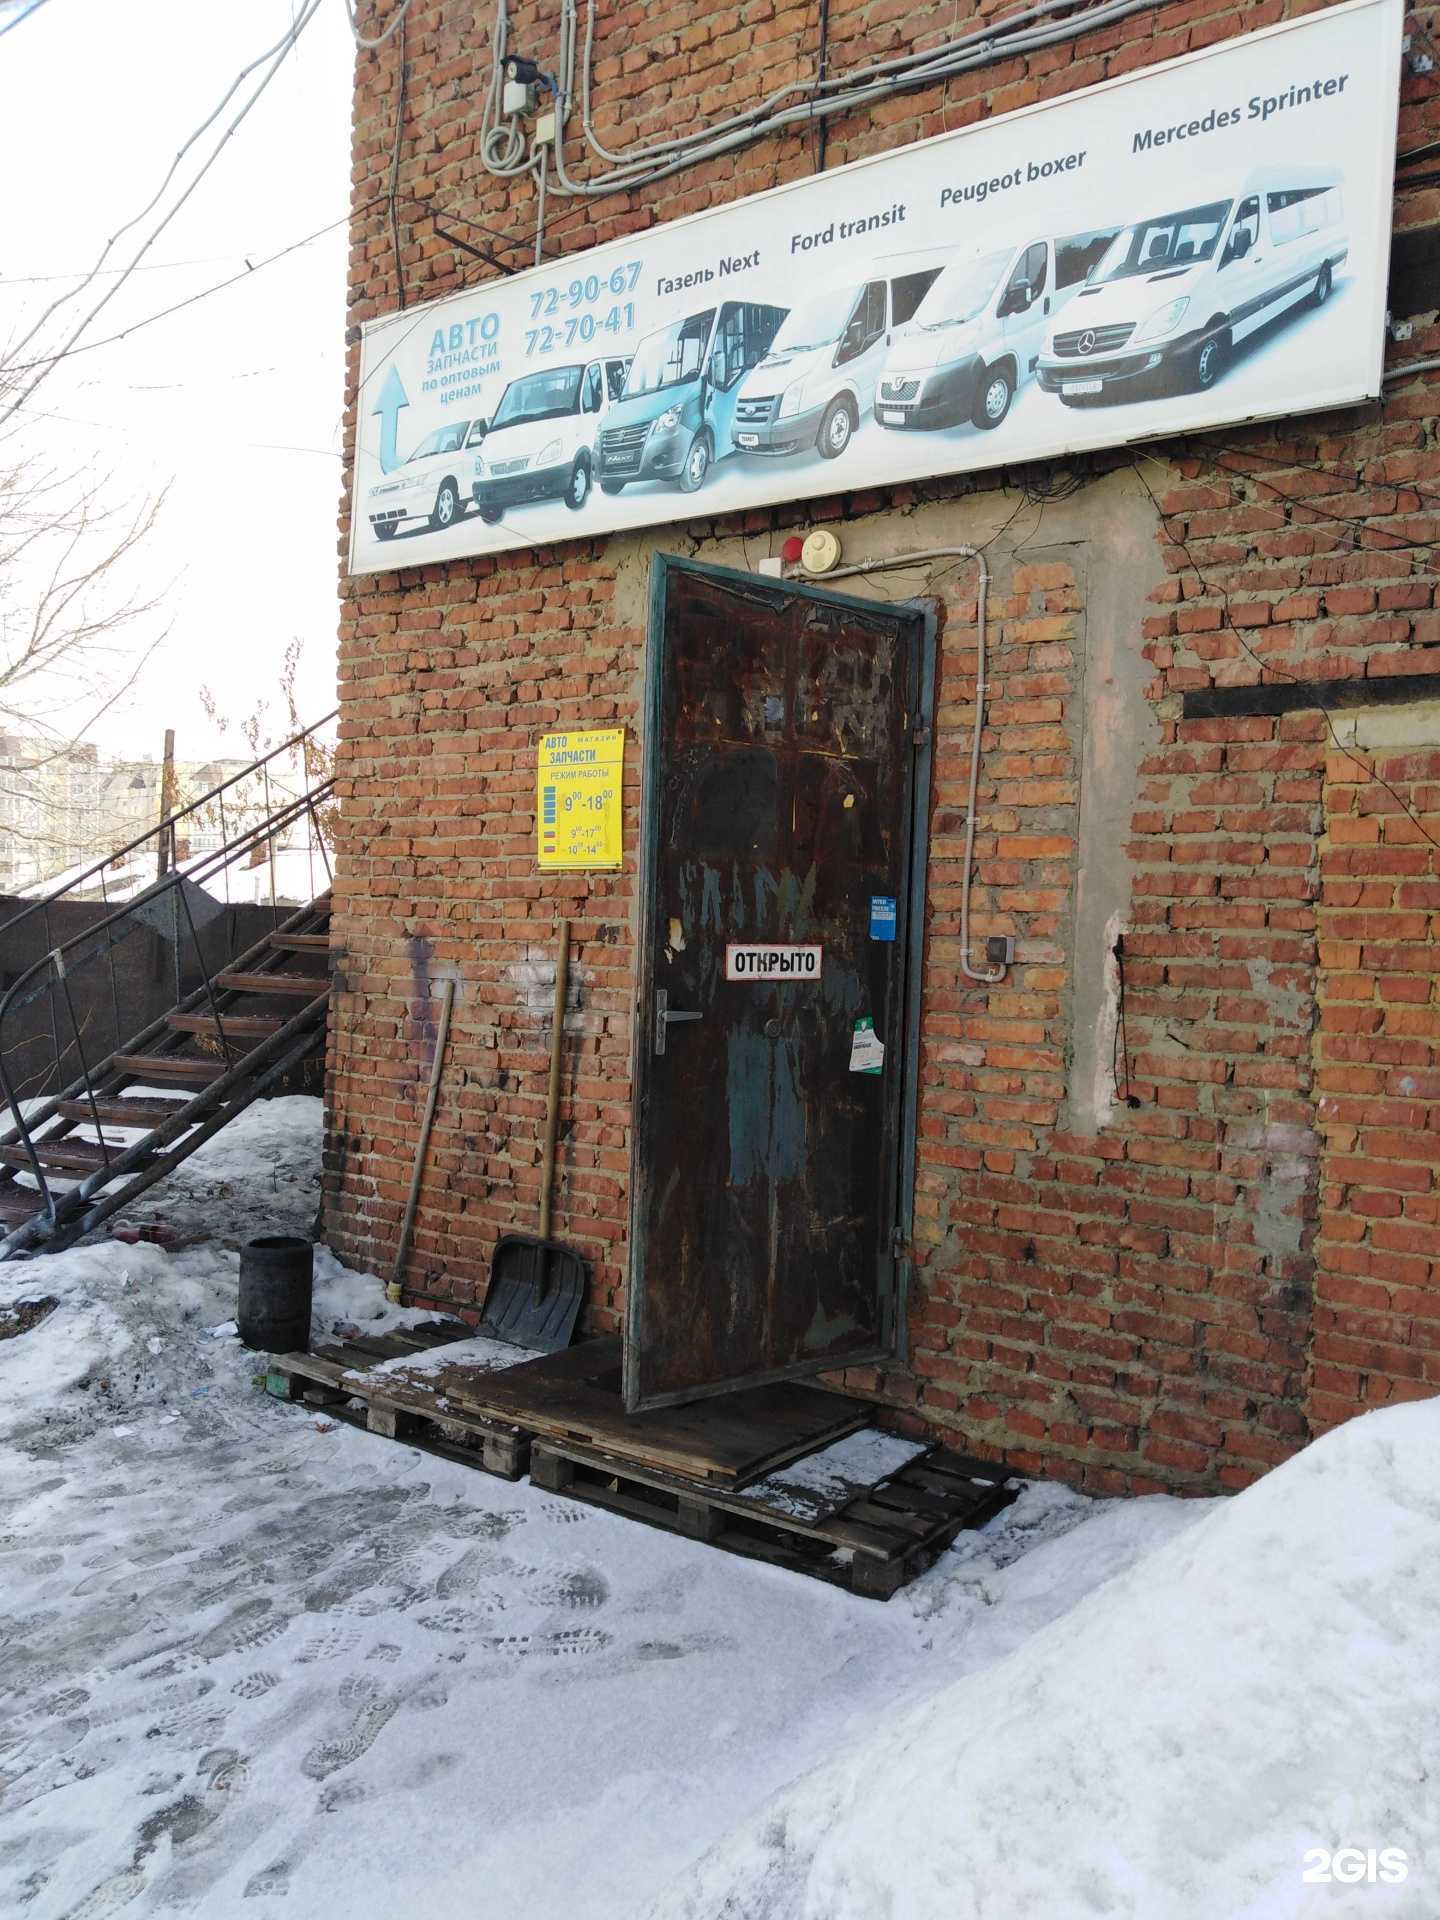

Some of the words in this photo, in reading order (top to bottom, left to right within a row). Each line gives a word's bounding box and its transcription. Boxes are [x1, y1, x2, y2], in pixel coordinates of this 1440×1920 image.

[1132, 108, 1241, 153] Mercedes
[1247, 74, 1349, 121] Sprinter
[940, 168, 1022, 208] Peugeot
[1027, 150, 1087, 182] boxer
[790, 224, 835, 254] Ford
[839, 204, 906, 239] transit
[530, 260, 643, 320] 72-90-67
[656, 266, 714, 296] Газель
[719, 250, 761, 277] Next
[429, 313, 500, 357] АВТО
[525, 302, 635, 357] 72-70-41
[422, 379, 438, 393] по
[440, 360, 501, 387] оптовым
[426, 341, 497, 374] ЗАПЧАСТИ
[440, 383, 481, 406] ценам
[545, 736, 567, 749] АВТО
[549, 749, 596, 764] ЗАПЧАСТИ
[550, 770, 577, 781] РЕЖИМ
[578, 768, 609, 779] РАБОТЫ
[735, 952, 815, 973] ОТКРЫТО
